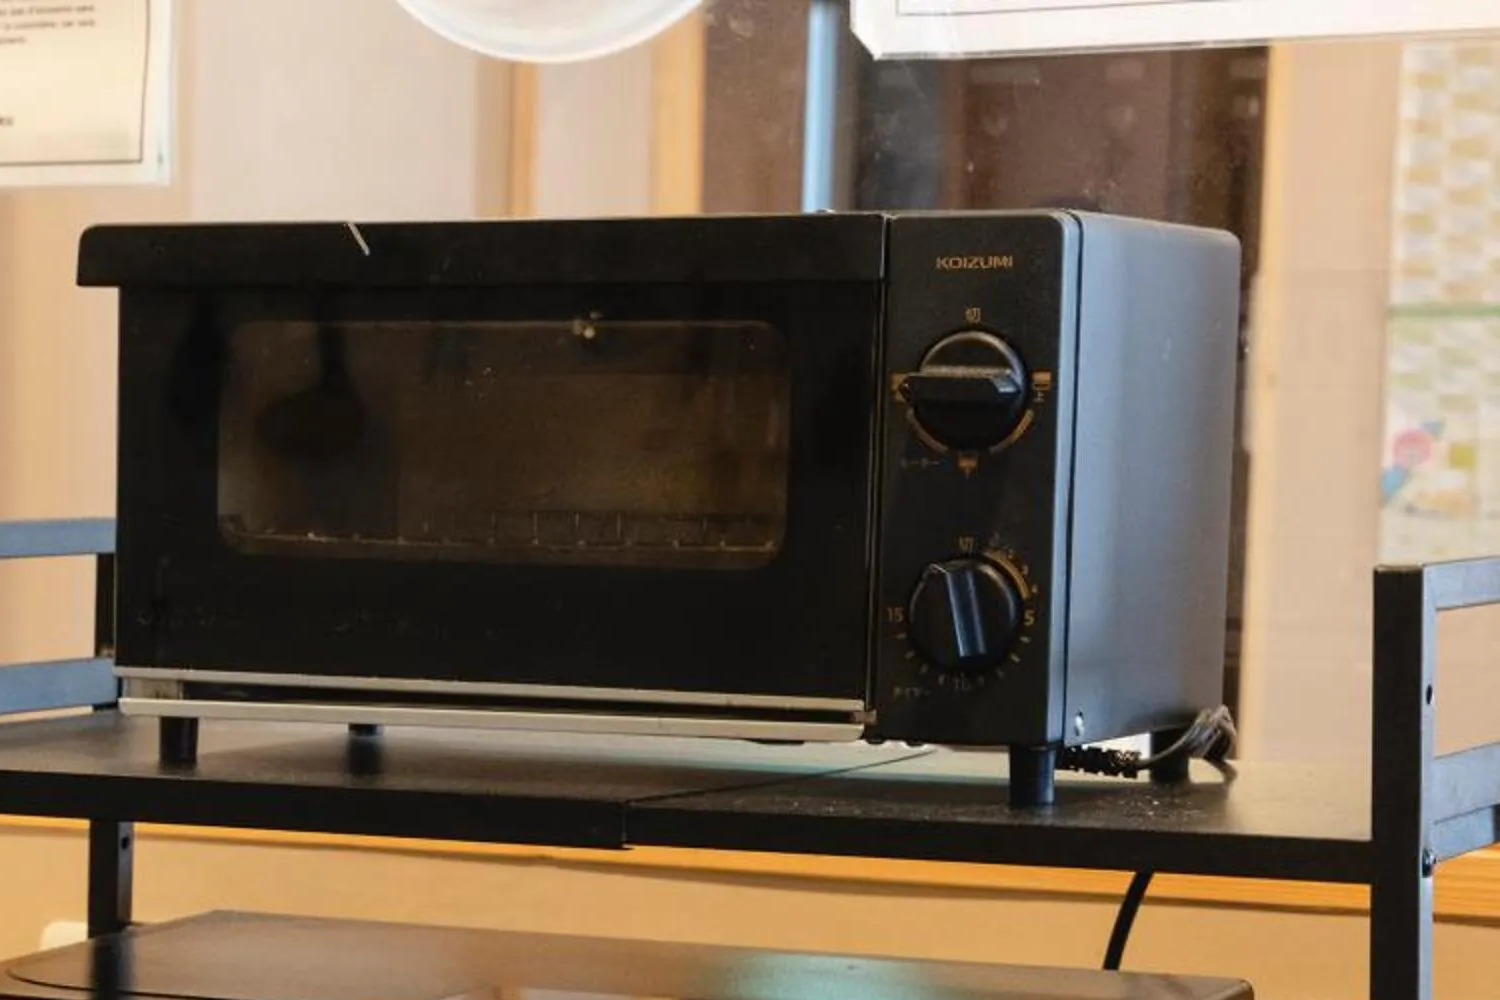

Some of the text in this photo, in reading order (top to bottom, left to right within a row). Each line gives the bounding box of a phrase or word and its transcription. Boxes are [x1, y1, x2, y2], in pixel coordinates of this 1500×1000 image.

[935, 255, 1014, 270] KOIZUMI
[965, 307, 981, 323] 切
[886, 607, 904, 623] 15
[1023, 609, 1036, 627] 5
